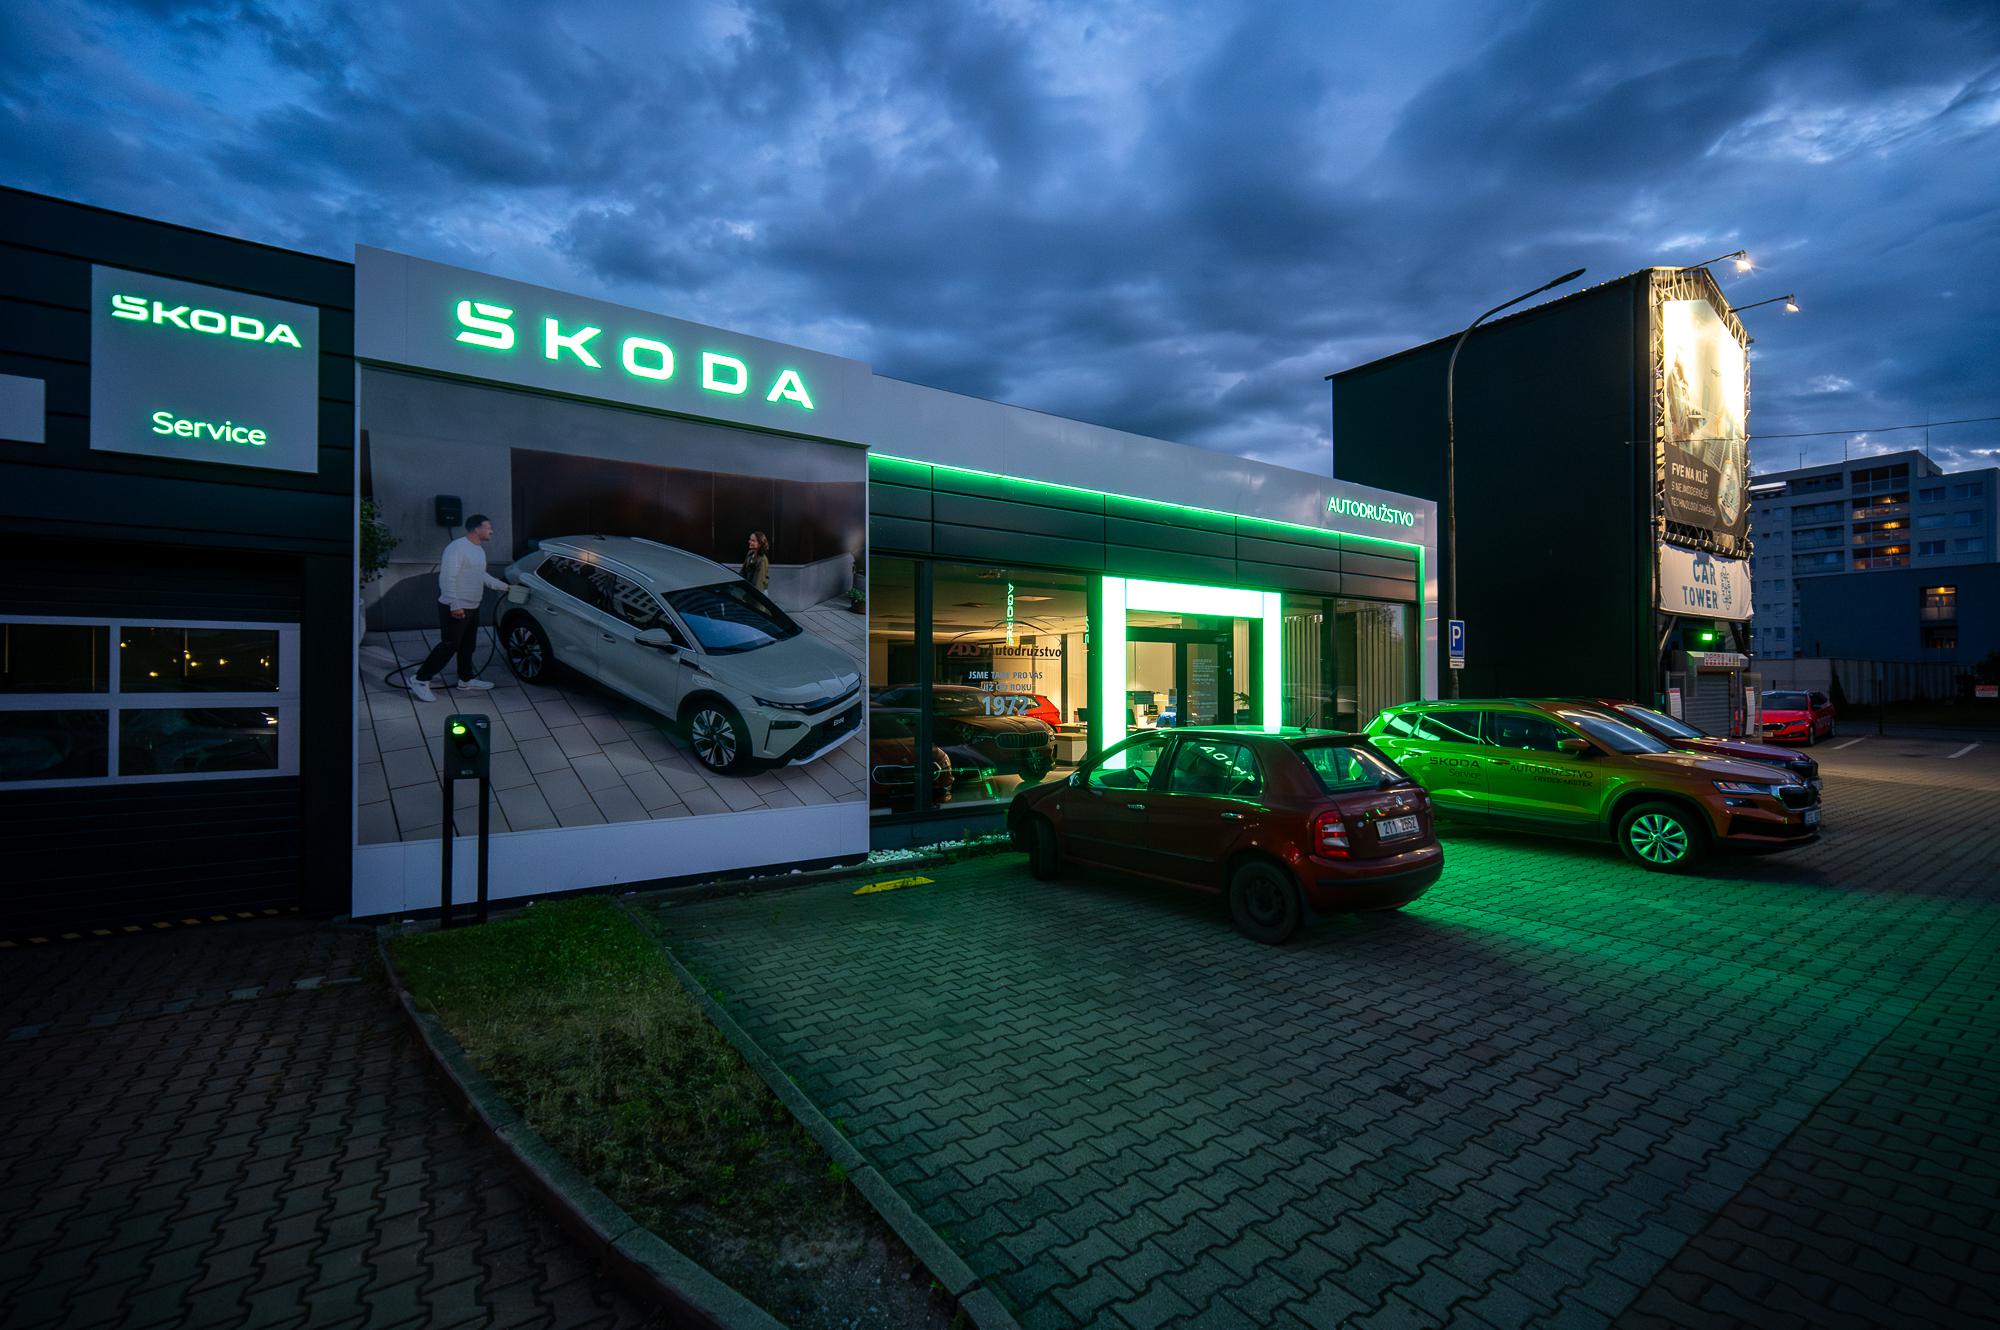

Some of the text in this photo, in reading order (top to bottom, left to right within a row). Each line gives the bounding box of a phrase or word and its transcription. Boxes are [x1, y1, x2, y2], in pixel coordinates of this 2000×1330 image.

[152, 411, 267, 445] Service
[1685, 466, 1695, 480] NA
[1327, 496, 1414, 527] AUTODRUŽSTVO
[1692, 559, 1717, 586] CAR
[1681, 585, 1719, 610] TOWER
[1451, 625, 1462, 647] P
[968, 671, 989, 680] JSME
[1013, 671, 1028, 680] PRO
[982, 695, 1029, 716] 1972
